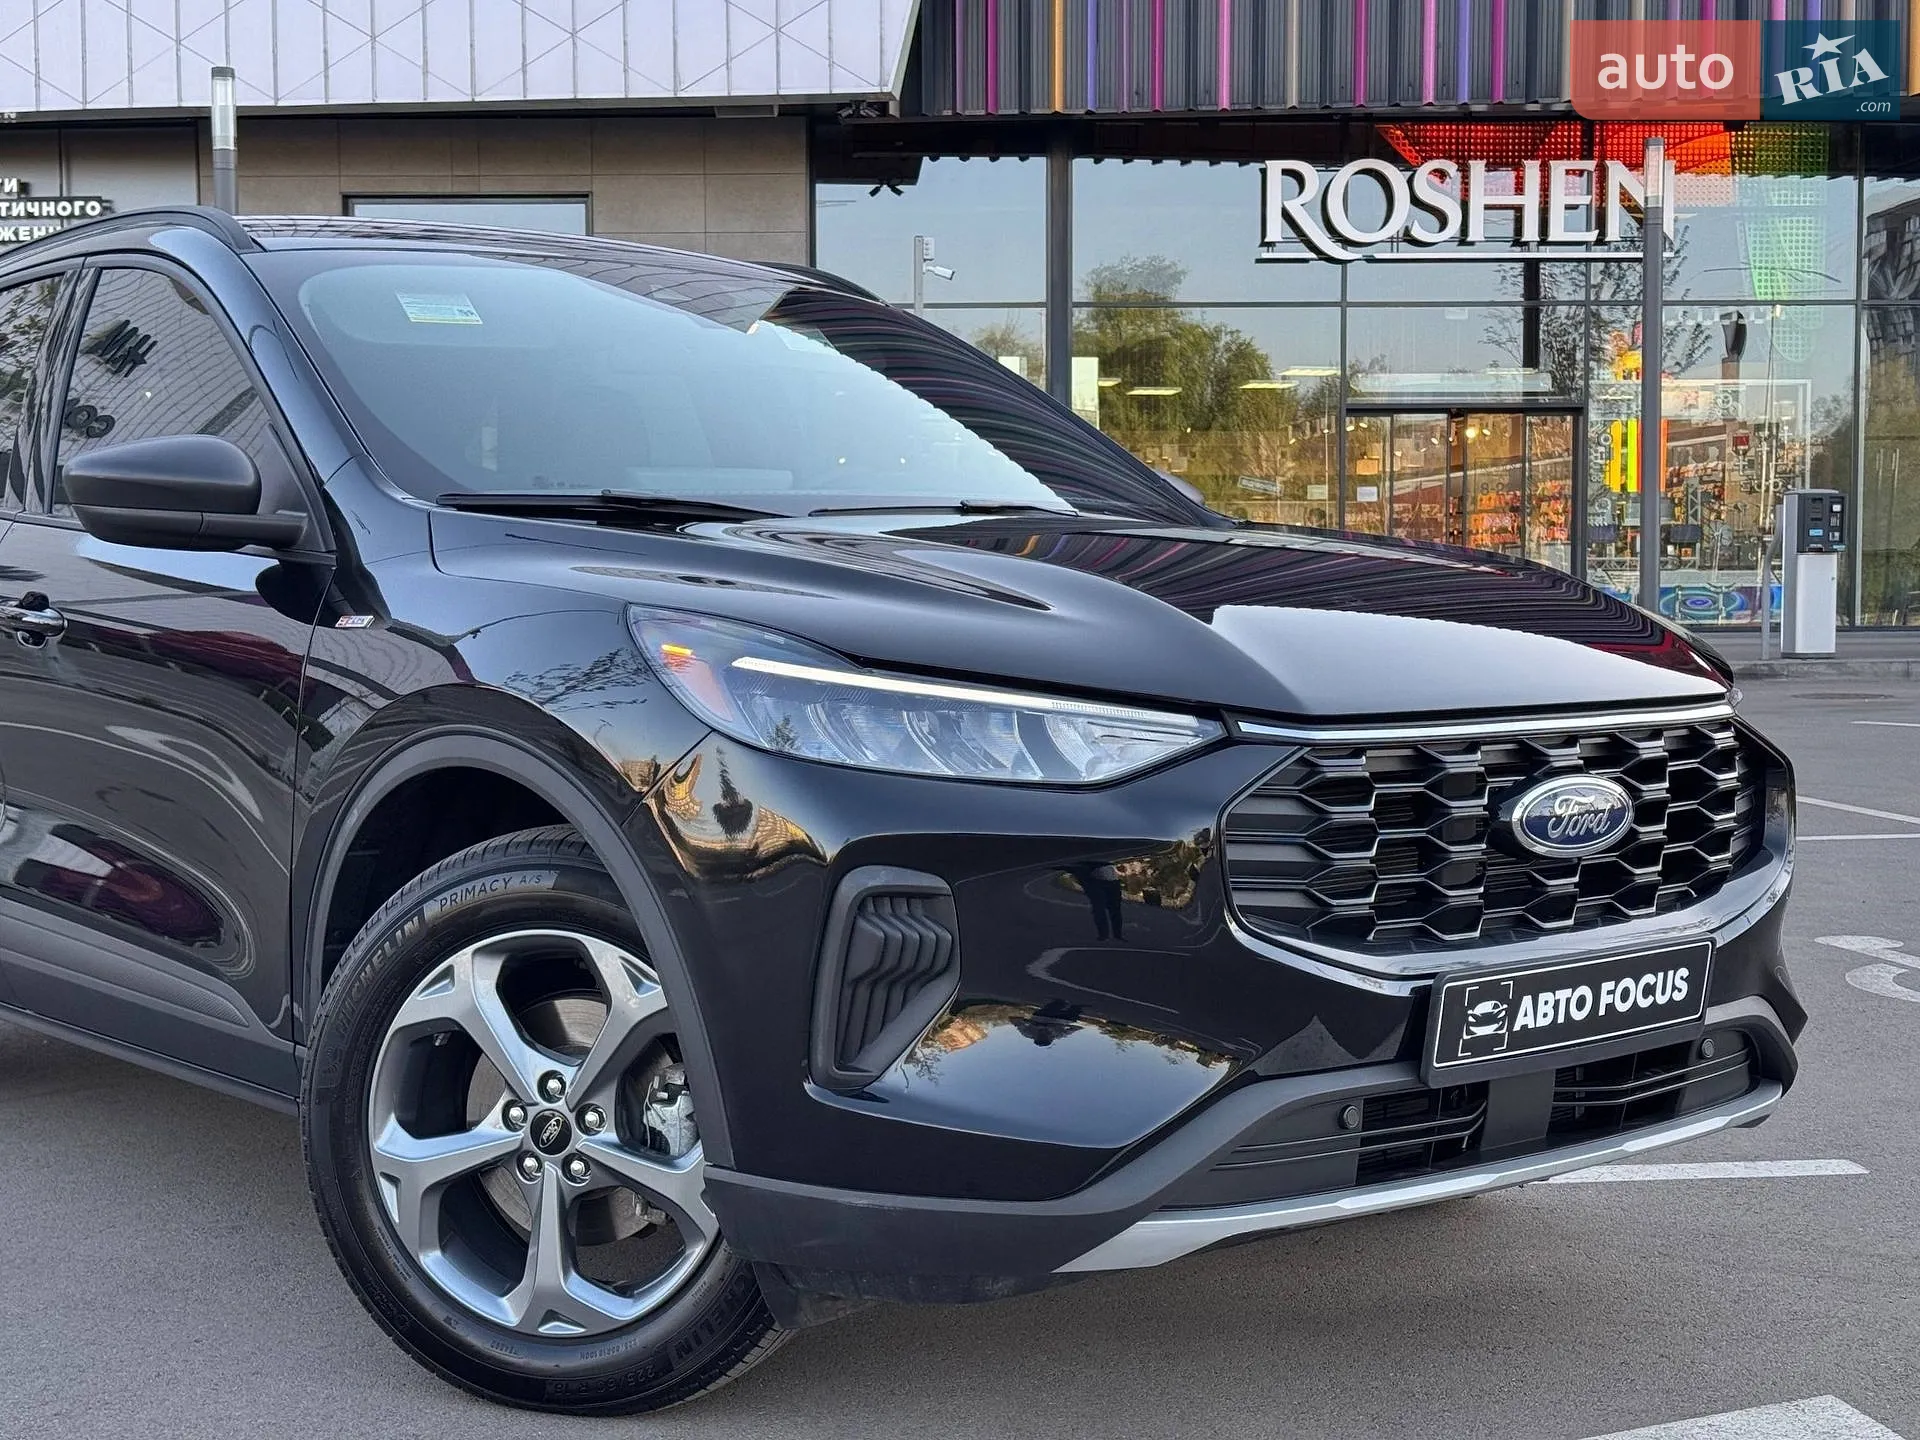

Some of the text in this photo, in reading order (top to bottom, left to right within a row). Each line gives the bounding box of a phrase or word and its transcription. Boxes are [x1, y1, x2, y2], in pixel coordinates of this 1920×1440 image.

[0, 200, 102, 217] ТИЧНОГО
[1264, 158, 1676, 261] ROSHEN
[0, 225, 61, 242] ЖЕН
[1547, 794, 1613, 839] Ford
[438, 874, 543, 912] PRIMACY A/S
[1598, 967, 1690, 1017] FOCUS
